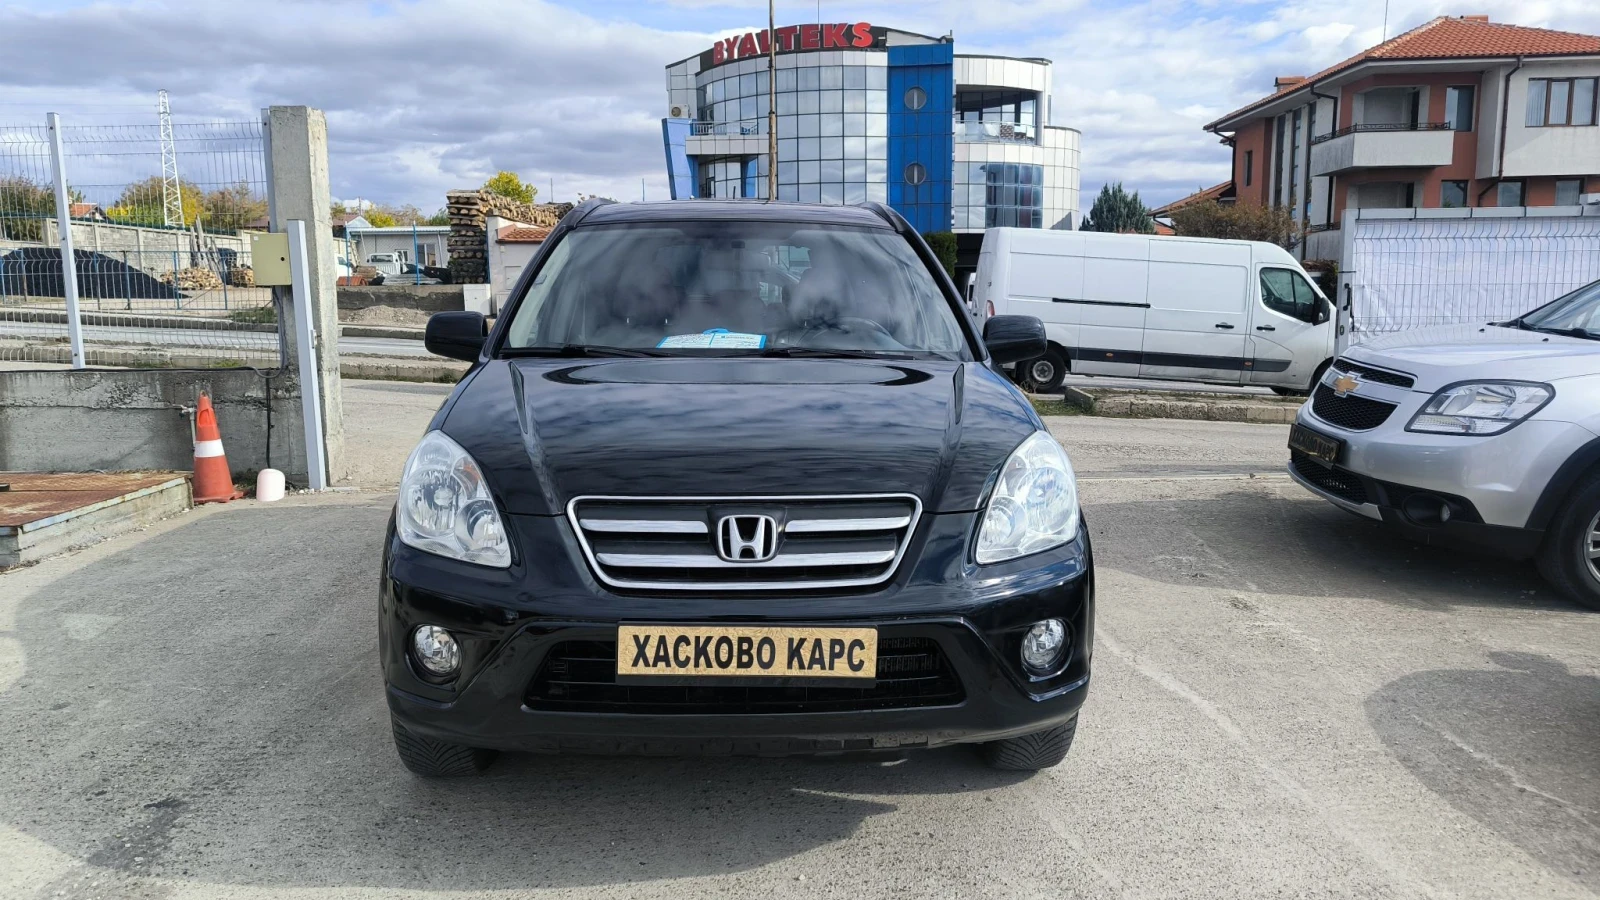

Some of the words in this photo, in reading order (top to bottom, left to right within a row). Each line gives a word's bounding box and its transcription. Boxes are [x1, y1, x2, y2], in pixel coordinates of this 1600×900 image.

[713, 22, 873, 65] BYALTEKS
[631, 634, 776, 669] ХАСКОВО
[787, 637, 865, 672] КАРС
